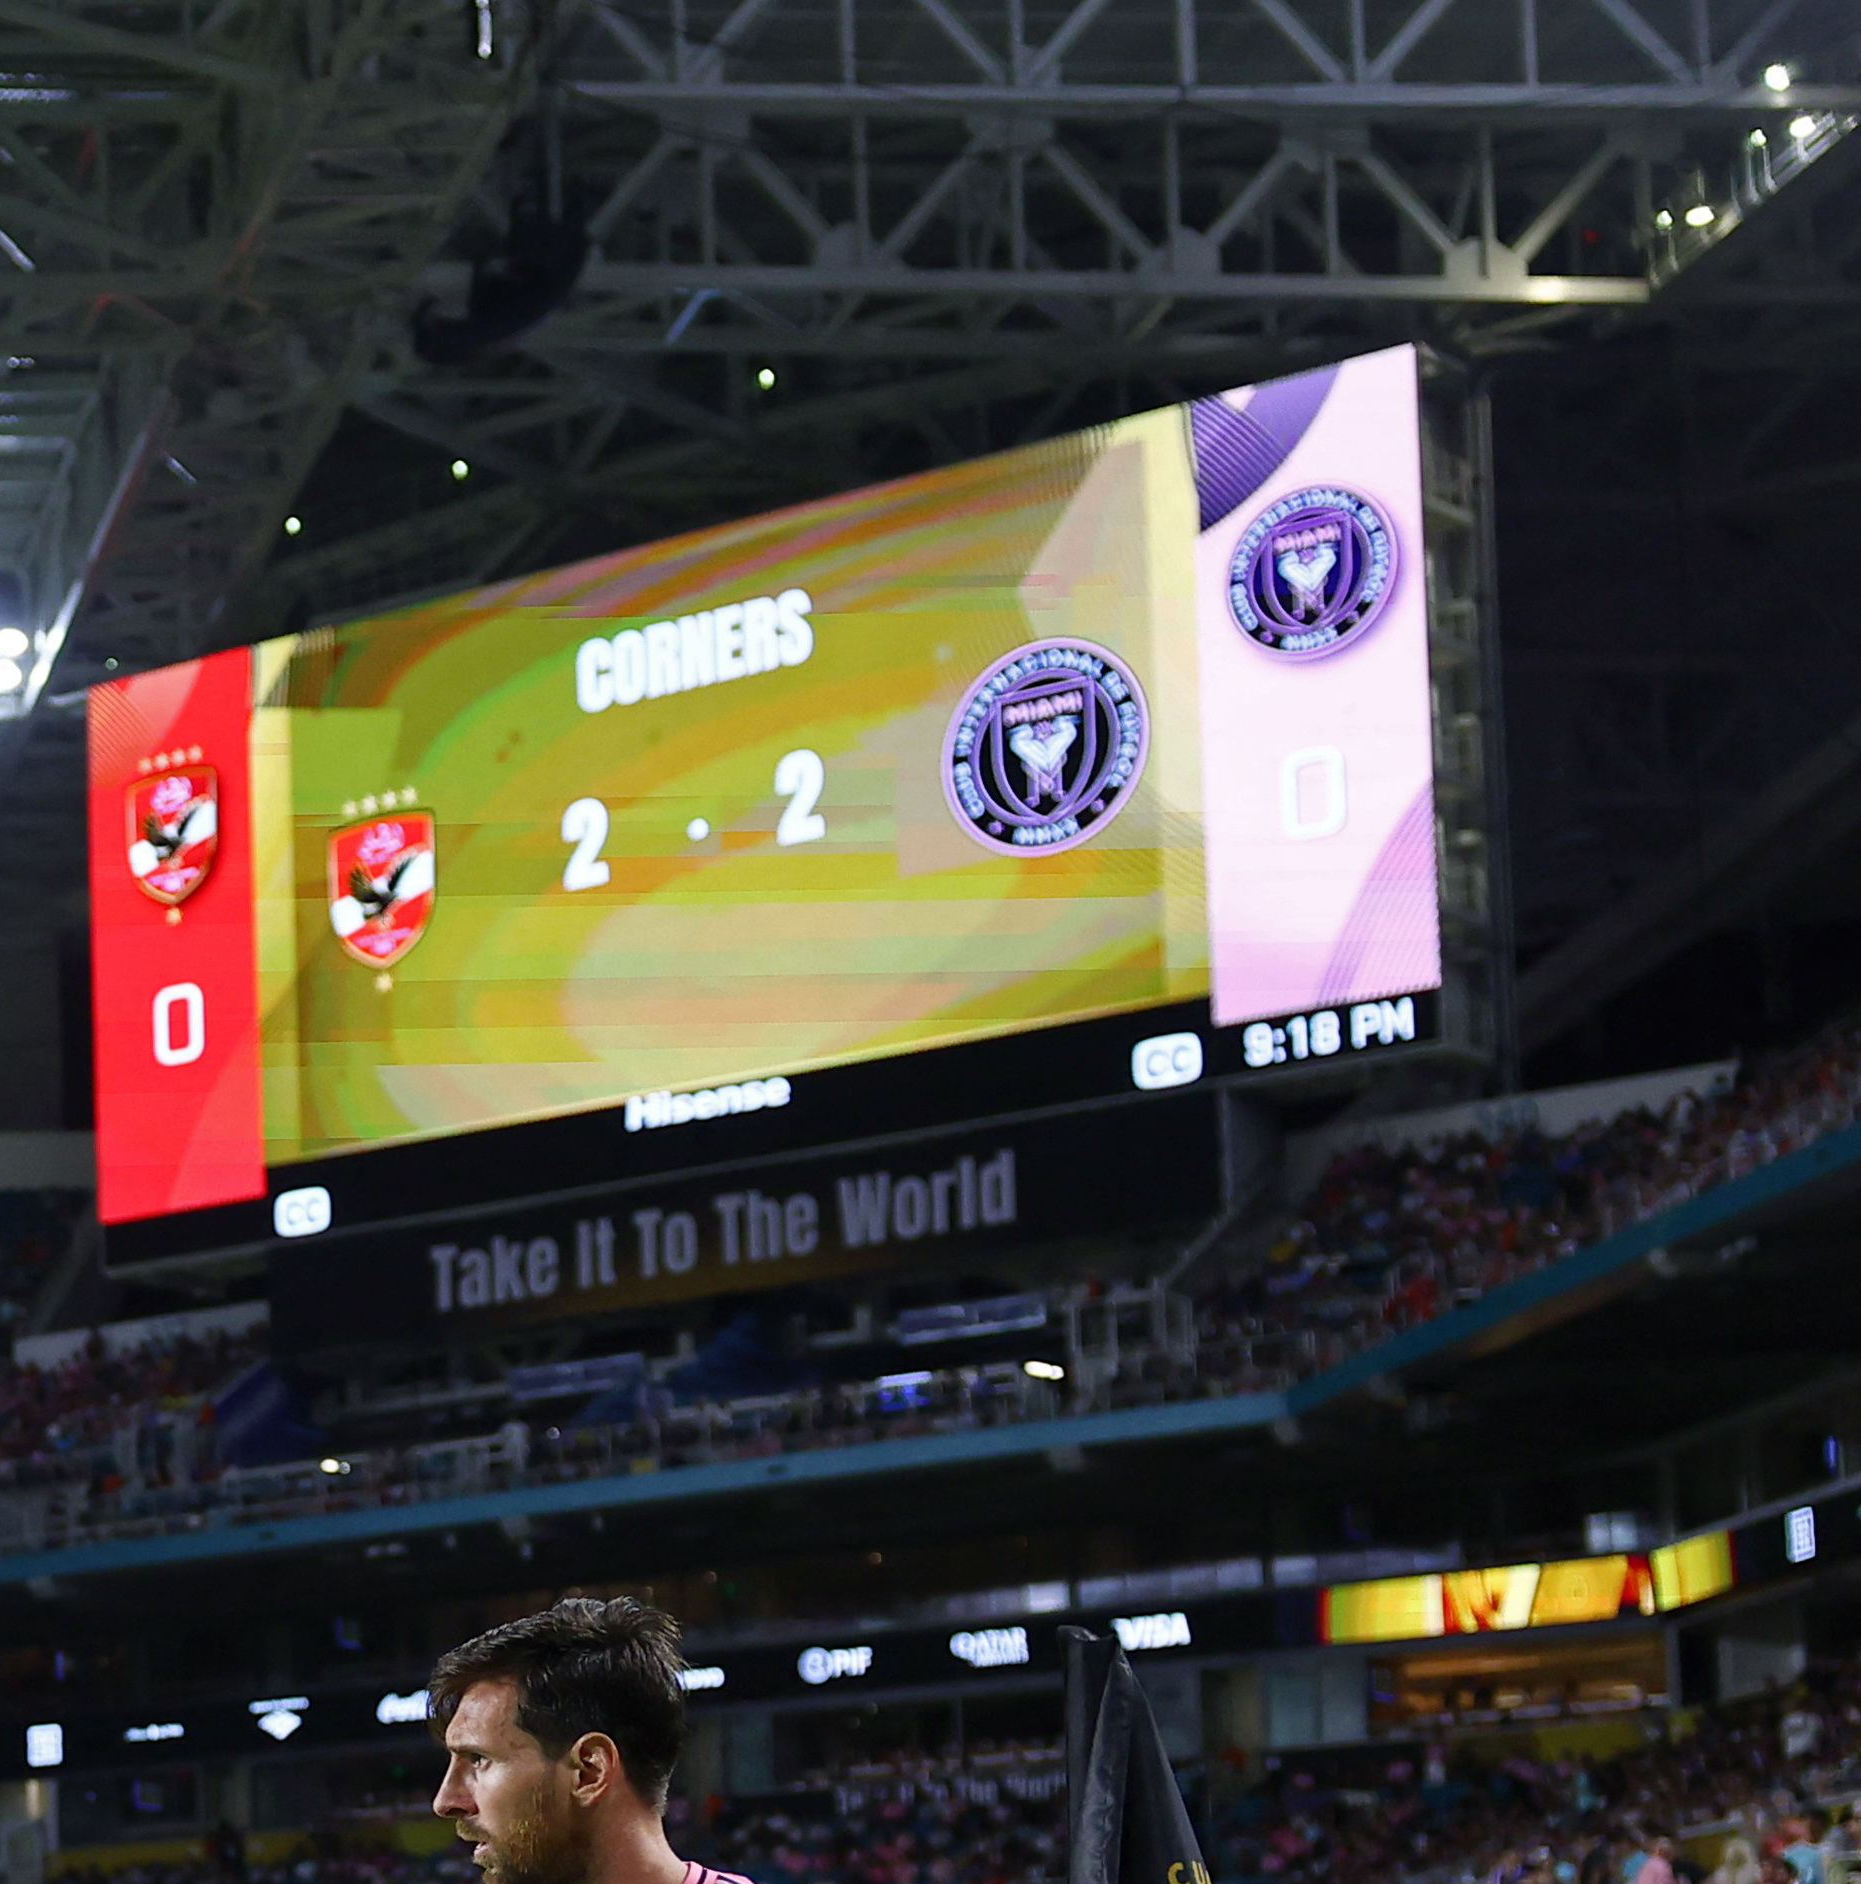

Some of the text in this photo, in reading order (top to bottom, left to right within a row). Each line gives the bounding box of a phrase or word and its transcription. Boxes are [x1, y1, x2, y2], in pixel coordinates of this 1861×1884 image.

[576, 588, 814, 713] CORNERS
[561, 748, 826, 891] 2 2
[1283, 744, 1348, 841] 0
[153, 981, 205, 1066] 0
[1350, 996, 1415, 1049] PM
[430, 1149, 1017, 1313] Take It To The World
[1111, 1612, 1191, 1651] VISA
